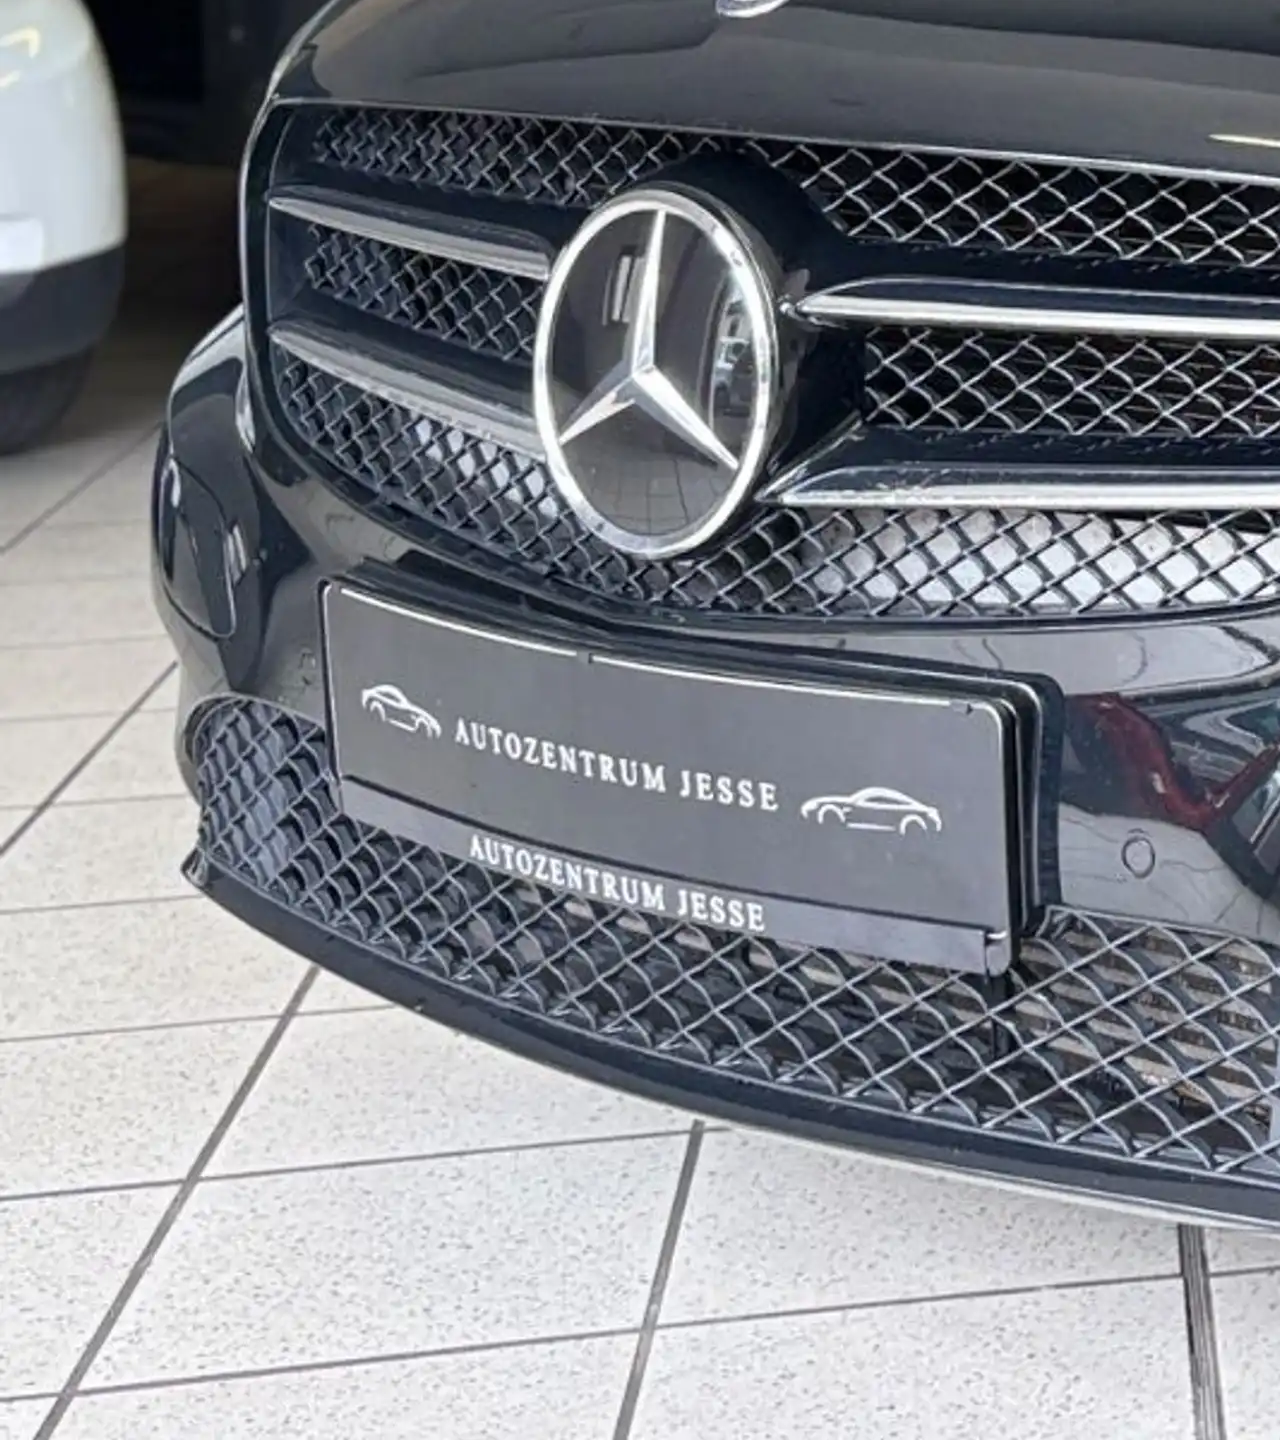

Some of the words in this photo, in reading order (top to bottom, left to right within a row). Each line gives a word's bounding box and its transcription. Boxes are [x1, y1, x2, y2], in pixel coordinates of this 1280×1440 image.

[454, 717, 667, 793] AUTOZENTRUM
[679, 769, 779, 811] JESSE
[469, 833, 666, 911] AUTOZENTRUM
[676, 888, 766, 931] JESSE
